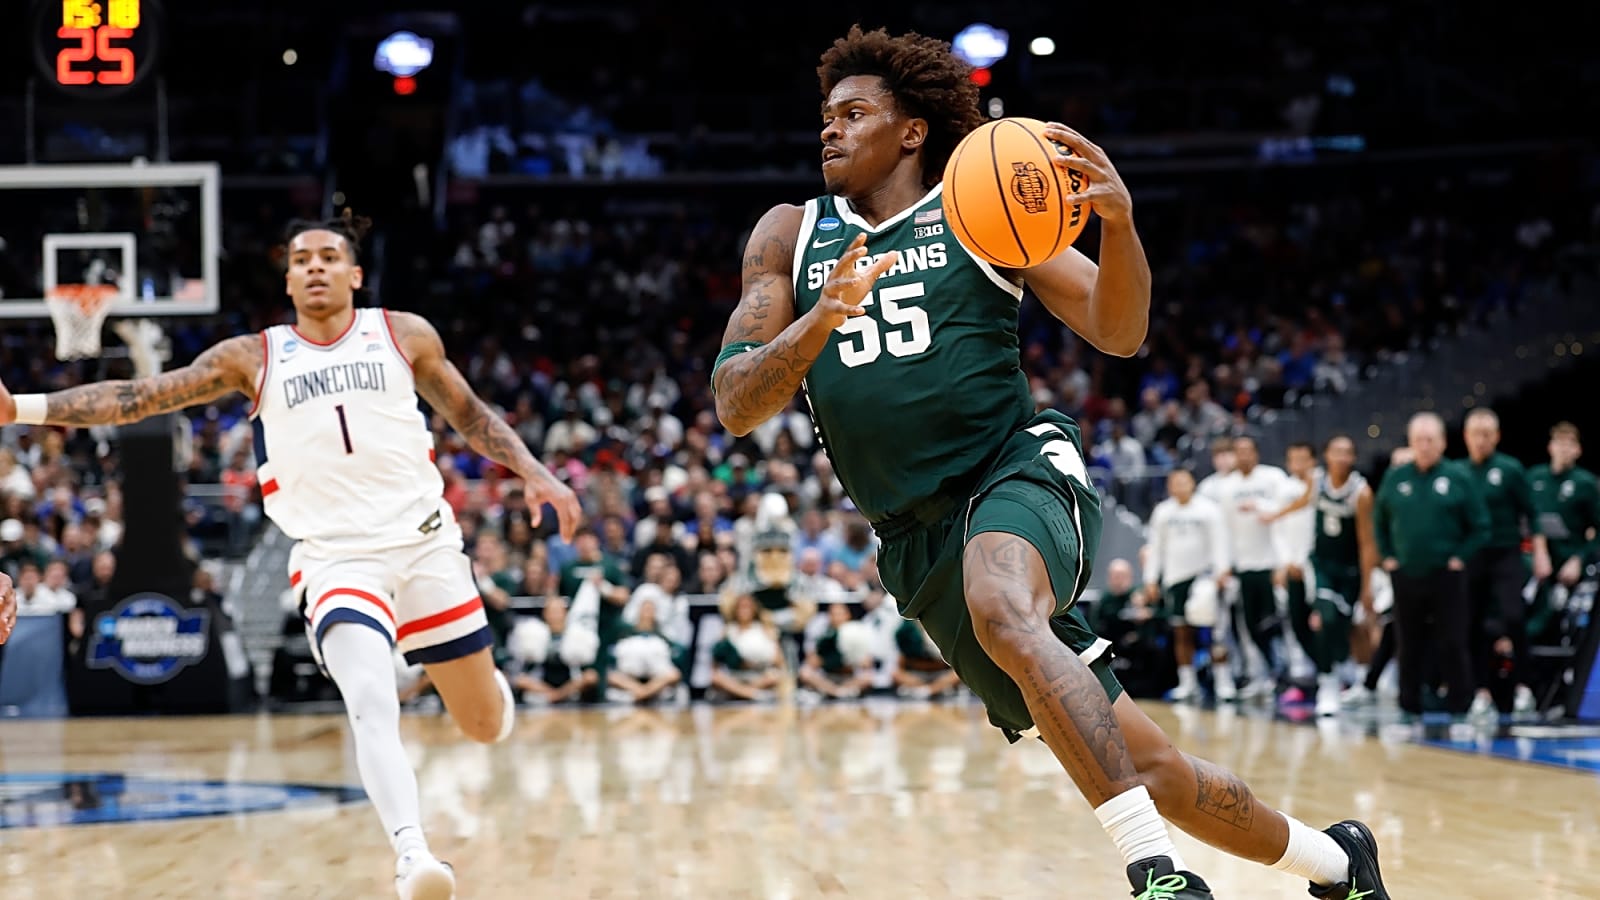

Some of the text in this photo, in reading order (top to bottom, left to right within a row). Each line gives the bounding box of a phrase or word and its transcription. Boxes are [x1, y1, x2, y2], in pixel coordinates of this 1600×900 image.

[56, 25, 135, 85] 25
[807, 242, 948, 291] SPRANS
[834, 282, 932, 368] 55
[283, 361, 386, 409] CONNECTICUT
[335, 404, 353, 455] 1
